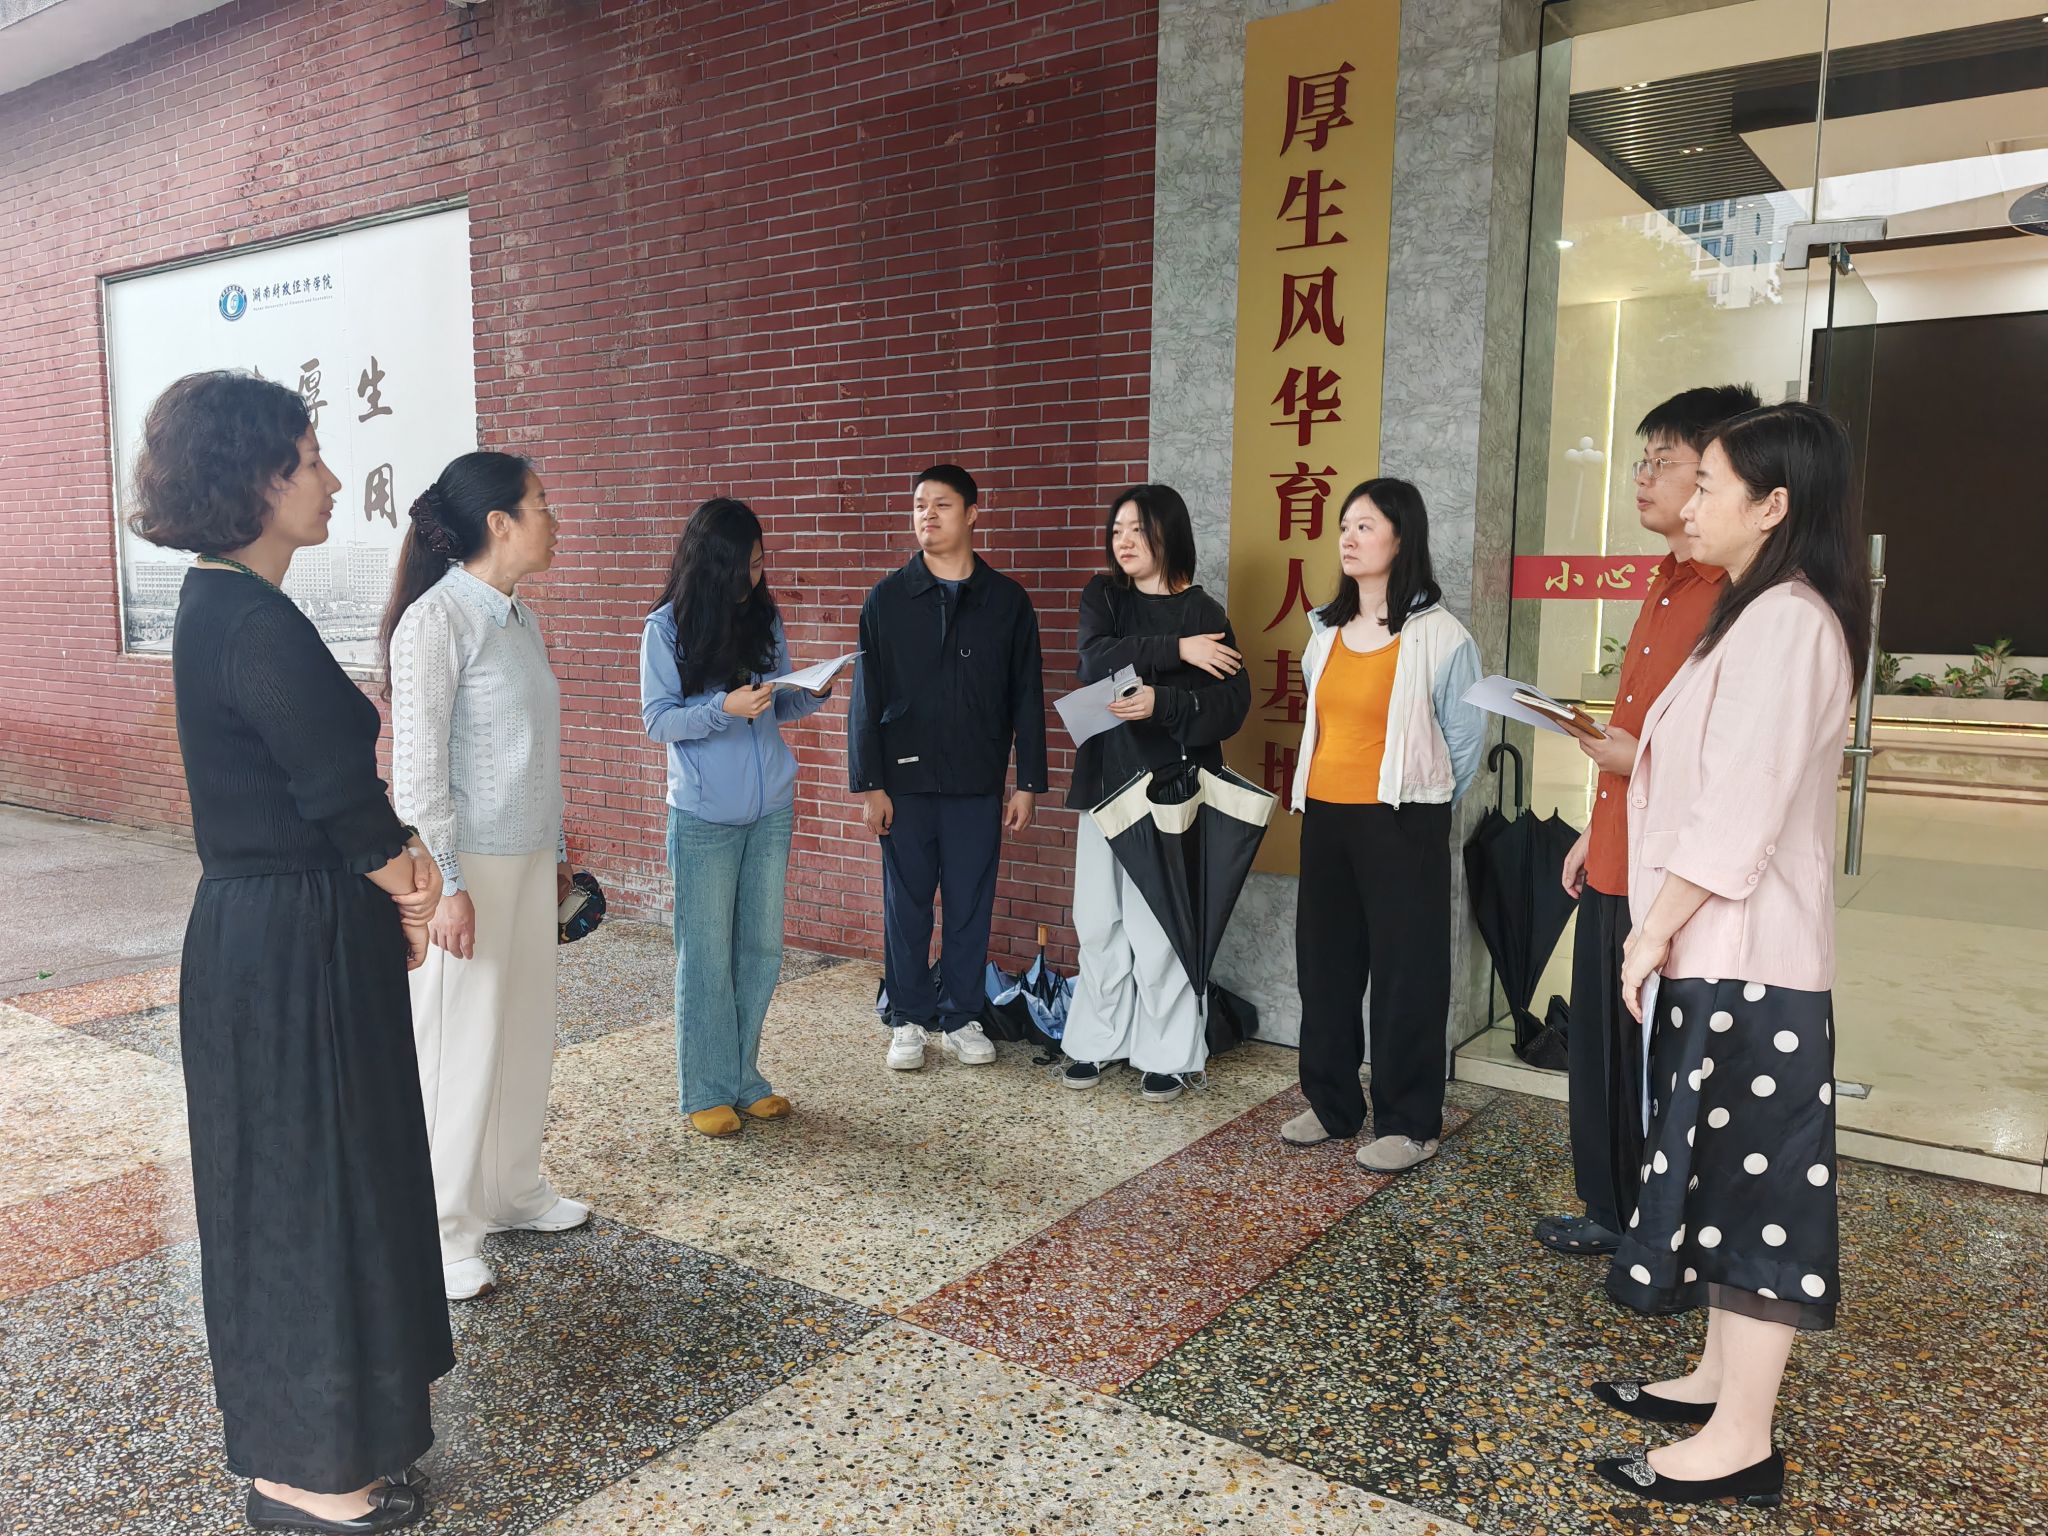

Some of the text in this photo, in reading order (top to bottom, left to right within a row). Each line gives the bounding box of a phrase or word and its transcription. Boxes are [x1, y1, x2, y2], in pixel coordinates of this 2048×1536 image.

[252, 273, 333, 303] 湖南财政经济学院
[254, 355, 393, 430] 厚生
